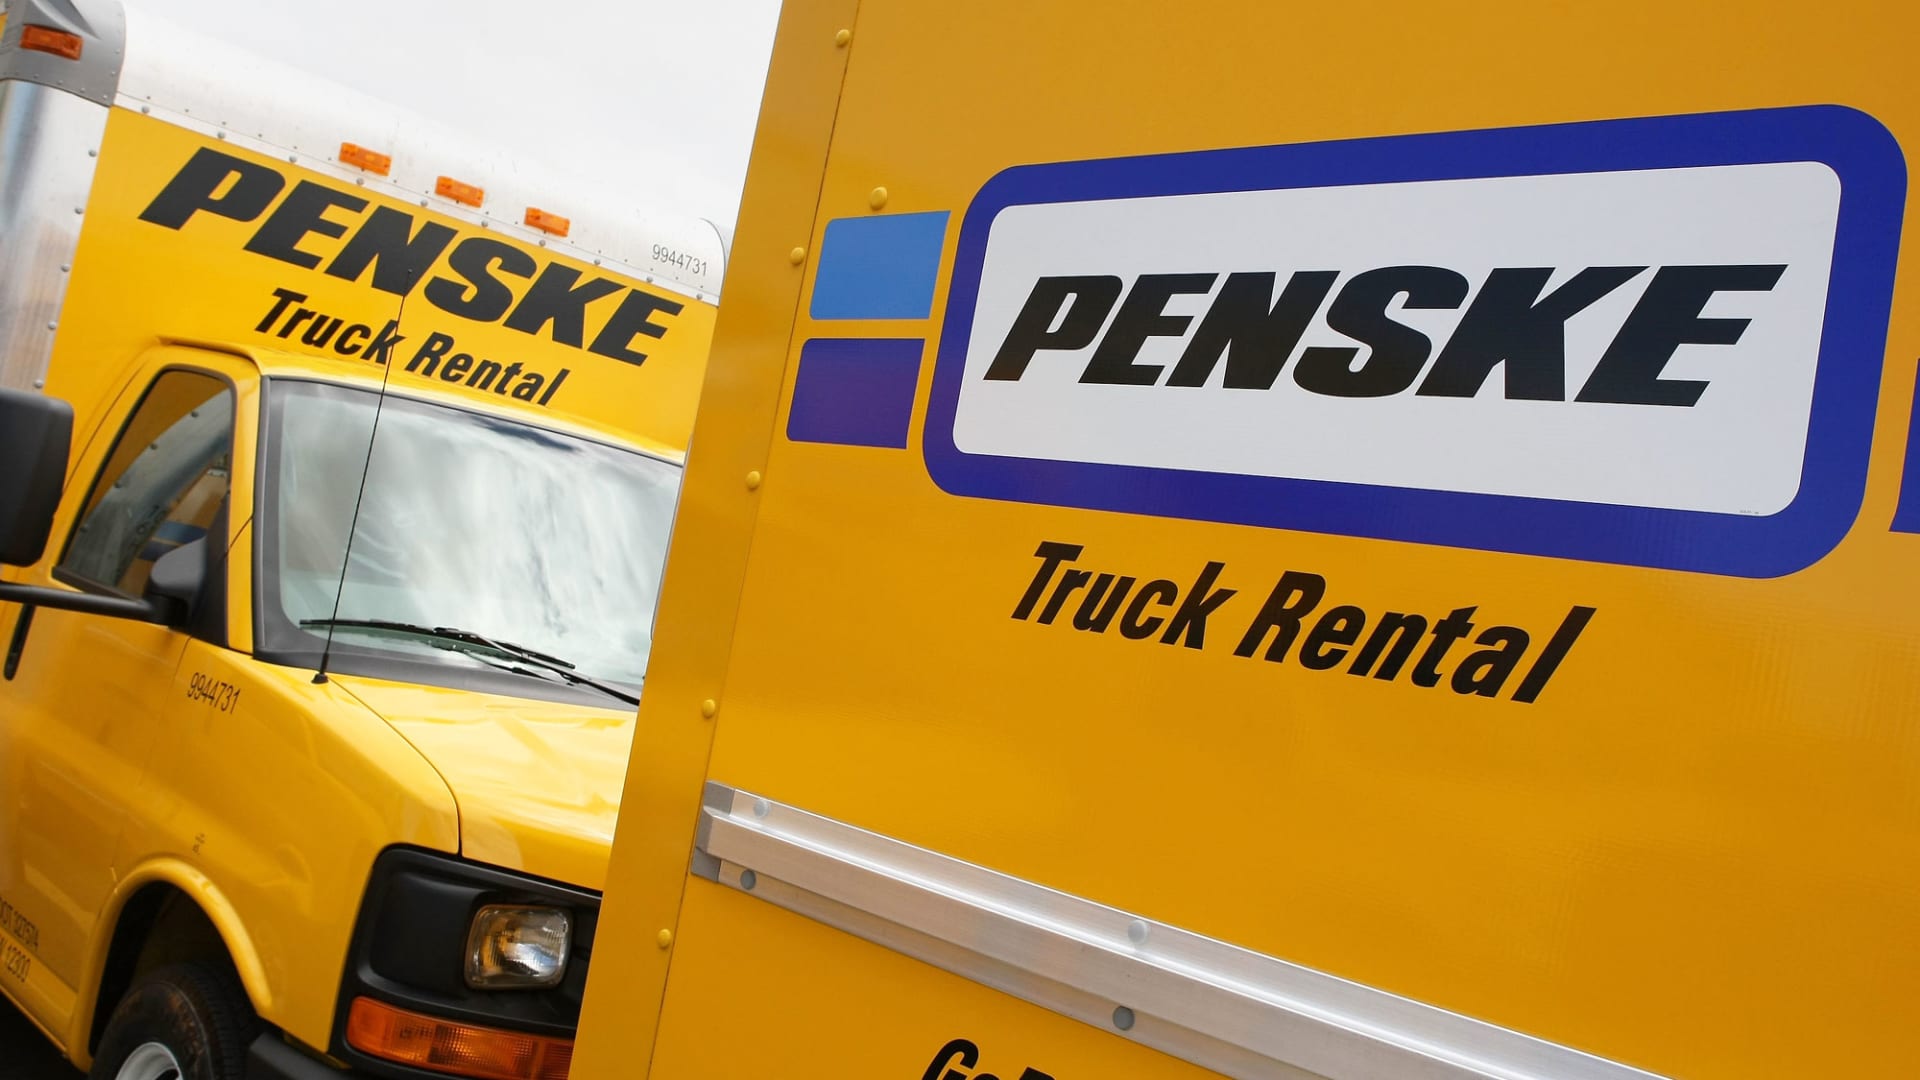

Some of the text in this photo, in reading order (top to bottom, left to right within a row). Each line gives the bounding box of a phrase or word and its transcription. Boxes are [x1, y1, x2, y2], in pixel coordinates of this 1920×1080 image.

[139, 147, 684, 367] PENSKE
[652, 243, 708, 277] 9944731
[256, 288, 570, 406] Truck Rental
[984, 264, 1788, 408] PENSKE
[1011, 541, 1597, 704] Truck Rental
[188, 671, 241, 714] 9944731
